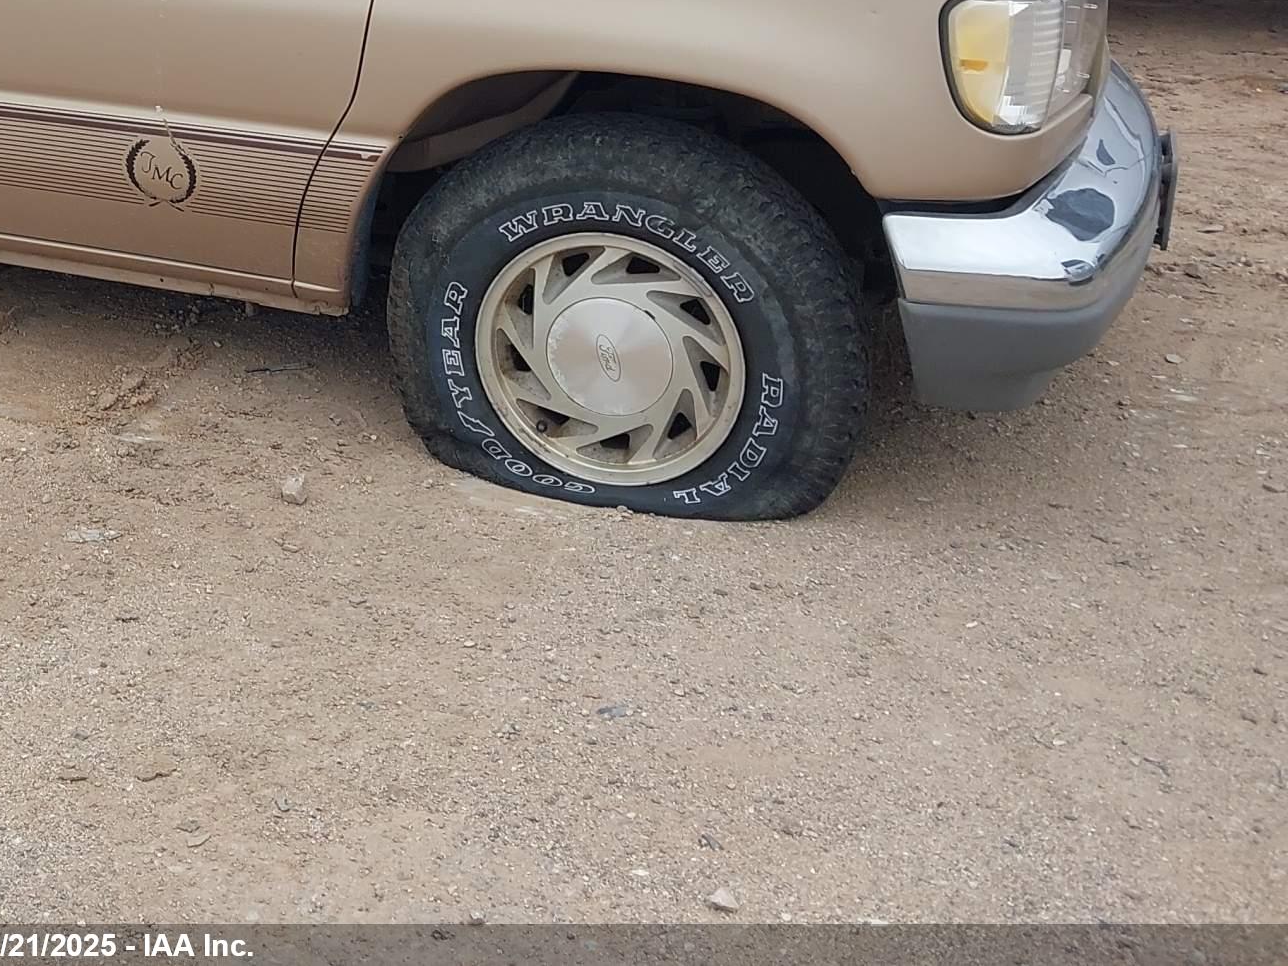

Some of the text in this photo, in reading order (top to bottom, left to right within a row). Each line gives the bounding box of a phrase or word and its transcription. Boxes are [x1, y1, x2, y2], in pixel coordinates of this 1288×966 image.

[499, 201, 755, 304] WRANGLER
[441, 281, 596, 494] GOODYEAR
[673, 372, 784, 505] RADIAL
